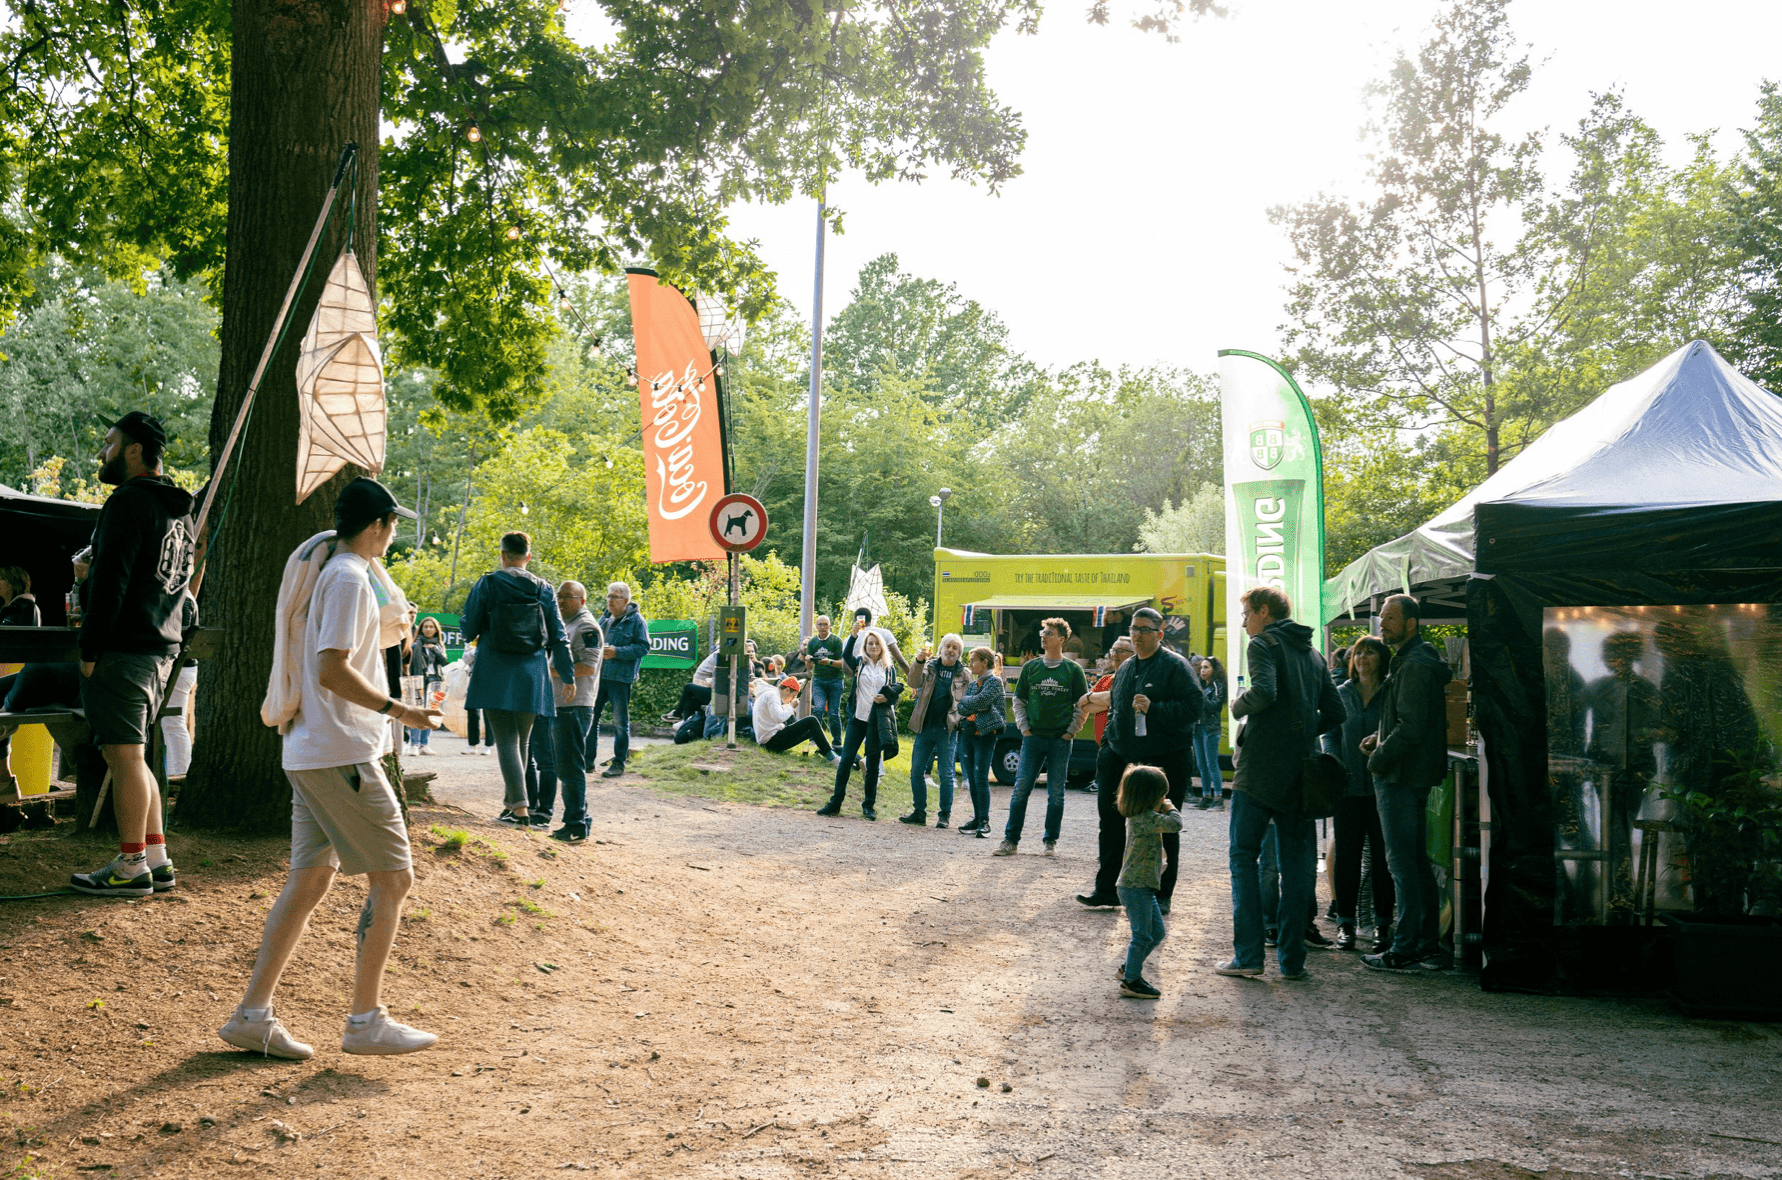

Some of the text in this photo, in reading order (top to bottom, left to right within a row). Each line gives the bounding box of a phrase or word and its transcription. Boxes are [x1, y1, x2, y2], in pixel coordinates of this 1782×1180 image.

[1015, 573, 1024, 584] TRY
[1025, 573, 1034, 584] THE
[1036, 572, 1073, 584] TRADITIONAL
[1075, 573, 1090, 584] TASTE
[1091, 573, 1099, 584] OF
